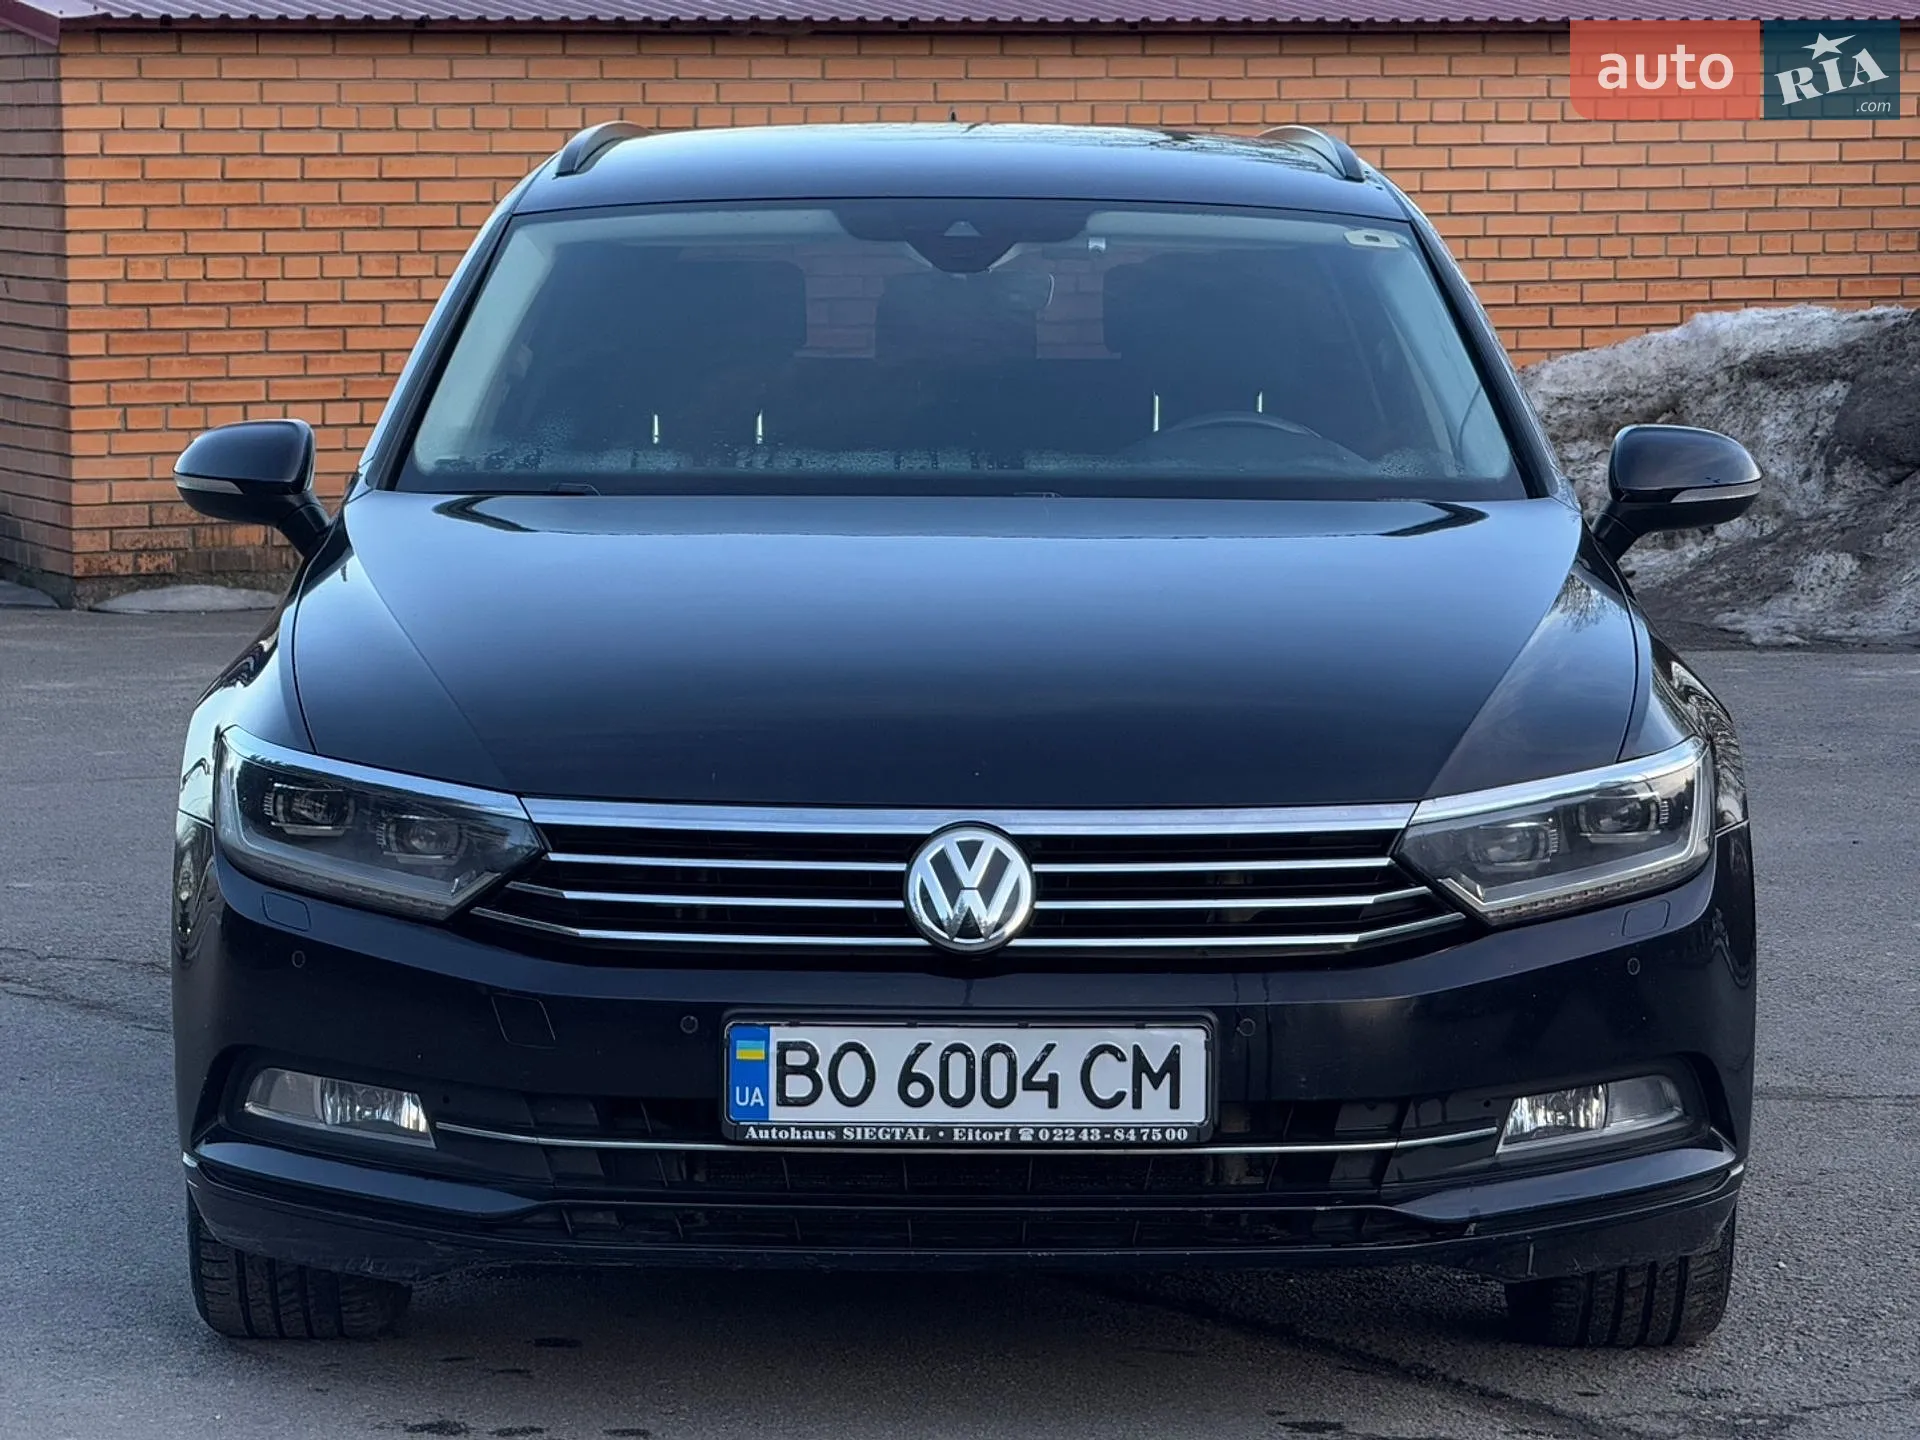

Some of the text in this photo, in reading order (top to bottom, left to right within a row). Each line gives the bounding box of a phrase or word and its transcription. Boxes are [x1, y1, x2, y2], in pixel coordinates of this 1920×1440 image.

[776, 1040, 1182, 1110] BO 6004 CM
[735, 1086, 765, 1107] UA
[745, 1126, 836, 1140] Autohaus
[842, 1126, 930, 1141] SIEGTAL
[952, 1127, 1011, 1141] Eitorf
